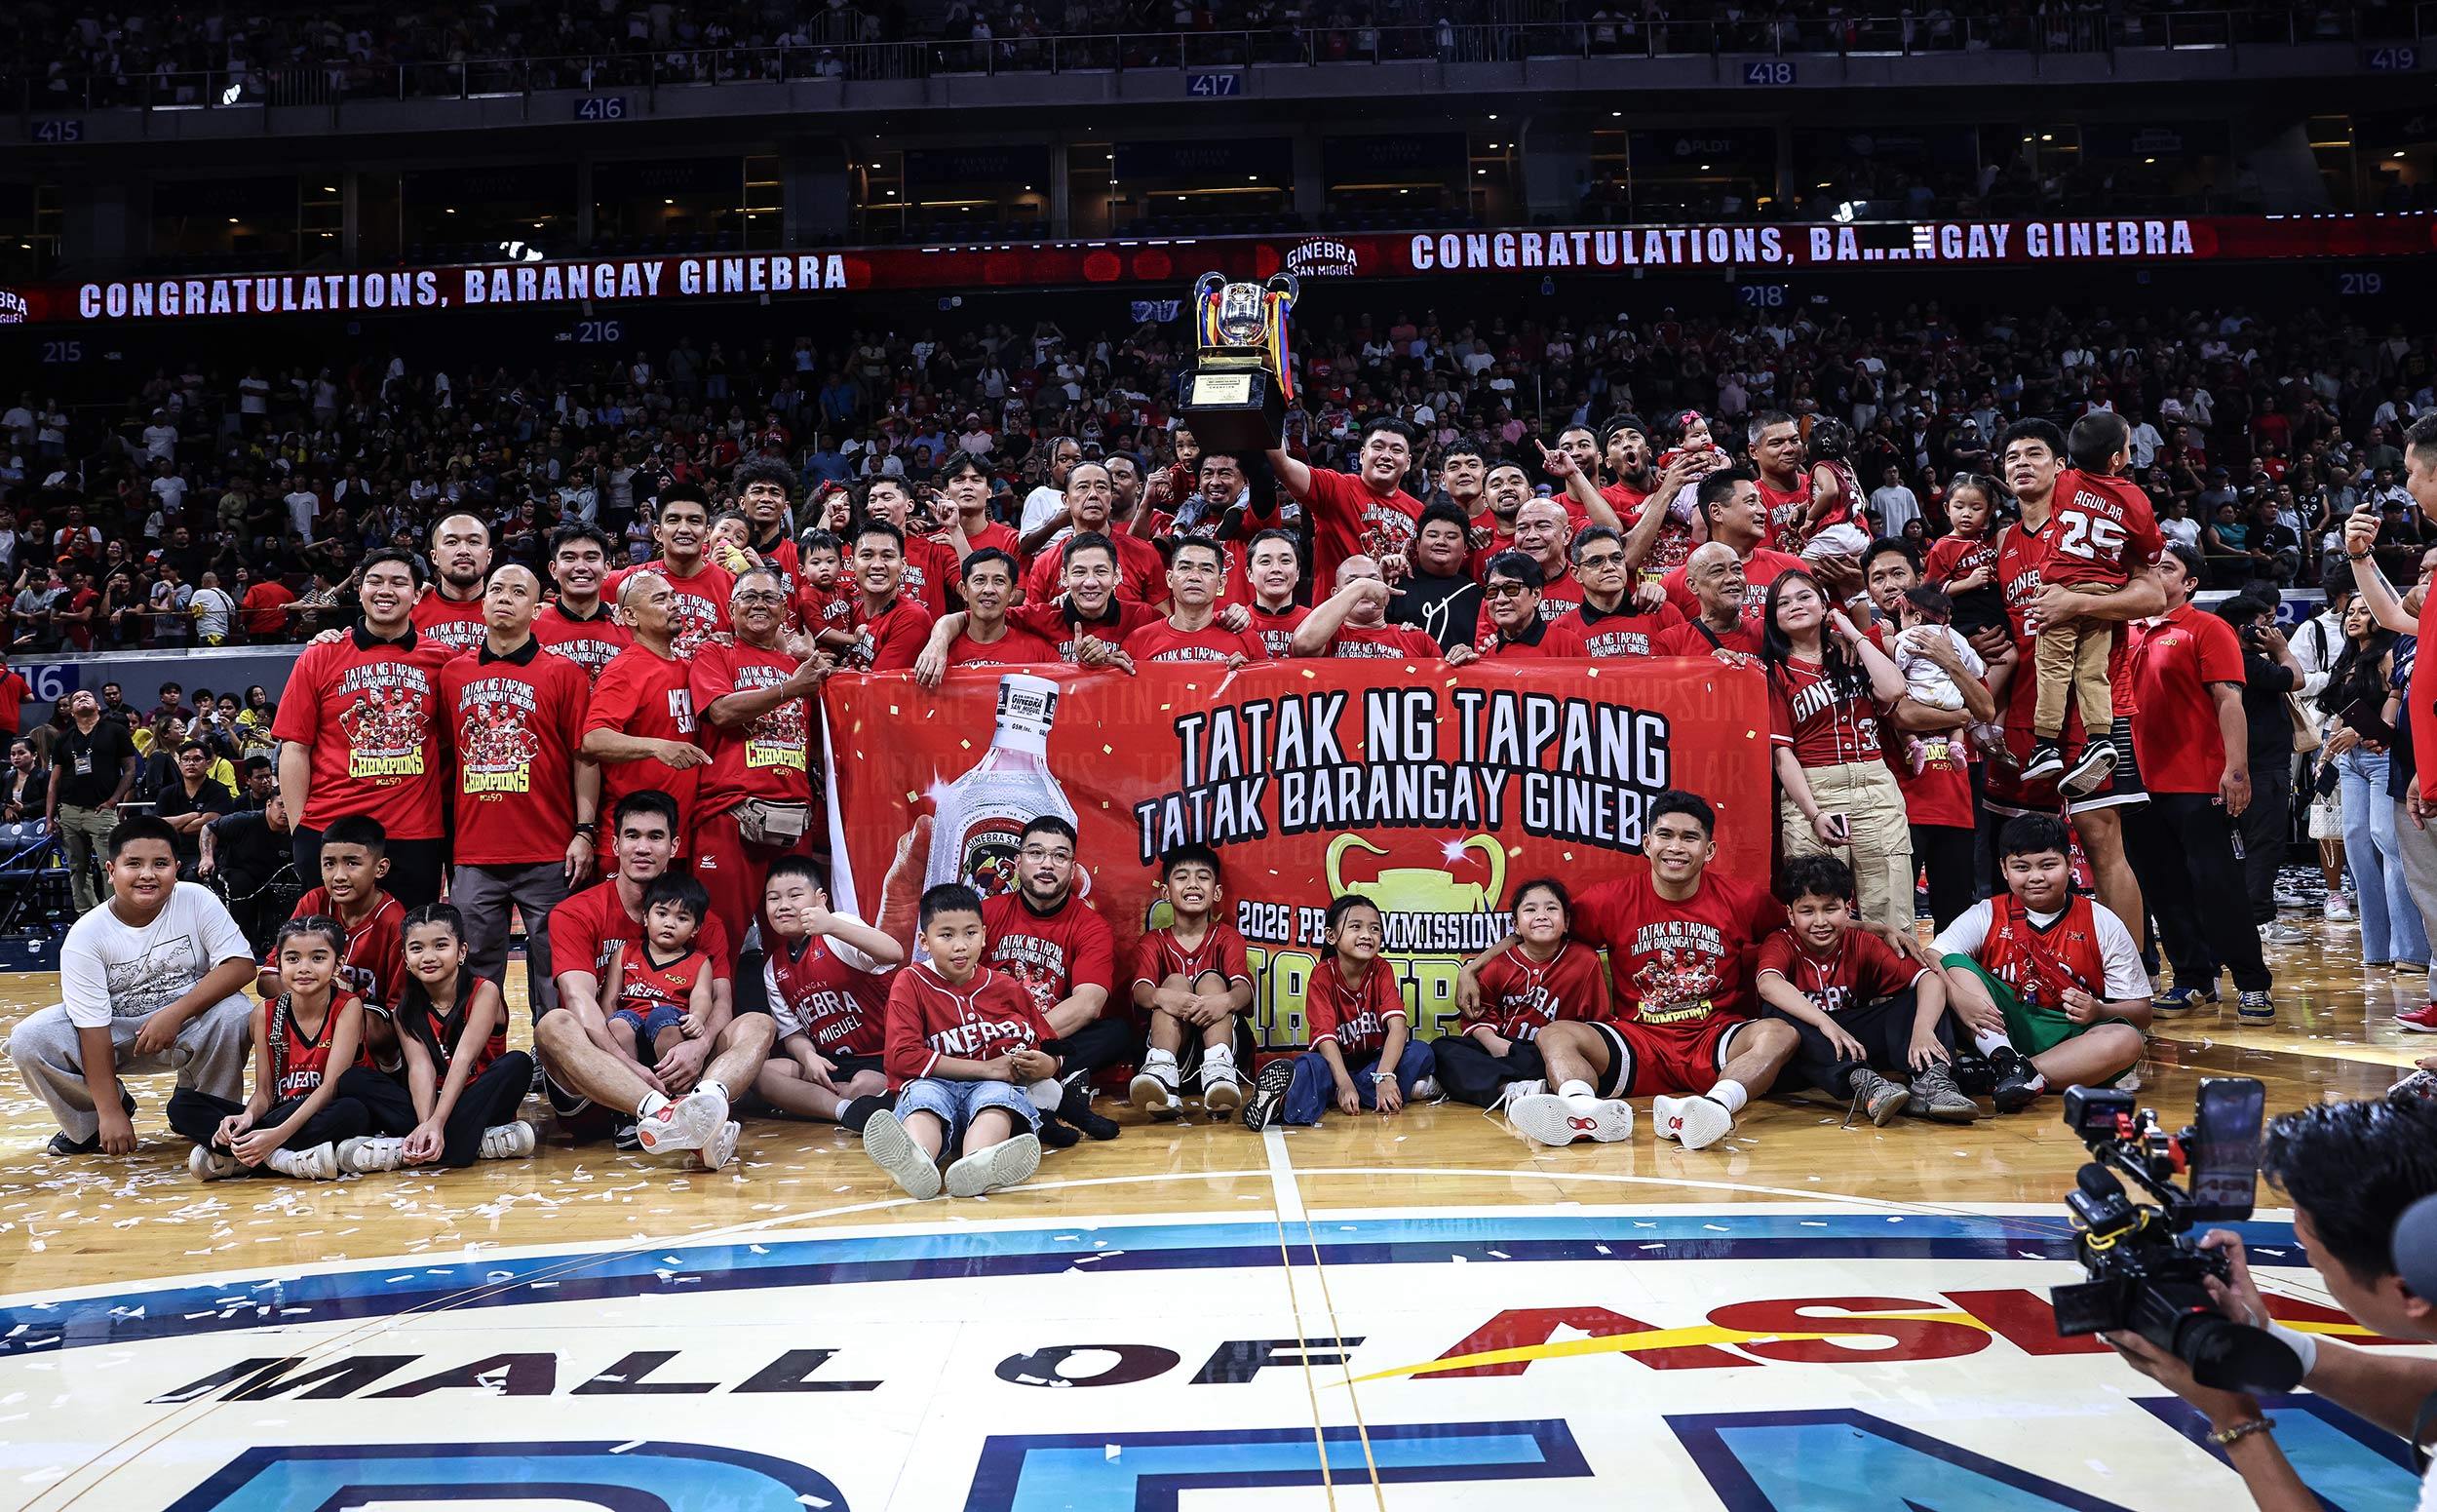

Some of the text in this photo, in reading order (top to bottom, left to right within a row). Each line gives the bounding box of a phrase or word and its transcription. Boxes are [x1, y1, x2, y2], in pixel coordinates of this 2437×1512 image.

[2370, 48, 2414, 69] 419
[1748, 64, 1792, 83] 418
[1192, 75, 1235, 95] 417
[579, 98, 622, 119] 416
[36, 121, 78, 141] 415
[1411, 226, 1794, 270] CONGRATULATIONS,
[2027, 219, 2194, 258] GINEBRA
[1287, 242, 1358, 268] GINEBRA
[1293, 264, 1355, 277] SAN MIGUEL
[79, 253, 847, 320] CONGRATULATIONS, BARANGAY GINEBRA
[2340, 274, 2382, 293] 219
[1741, 286, 1783, 306] 218
[579, 323, 621, 342] 216
[41, 341, 82, 363] 215
[2073, 489, 2124, 522] AGUILAR
[2058, 509, 2129, 562] 25
[2006, 569, 2041, 601] GINEB
[686, 595, 716, 614] TAPANG
[695, 605, 718, 625] GINEBRA
[425, 621, 487, 638] TATAK NG TAPA
[1267, 631, 1279, 641] NG
[1603, 634, 1614, 645] NG
[1615, 632, 1649, 646] TAPANG
[576, 640, 589, 652] NG
[590, 640, 622, 657] TAPANG
[1180, 647, 1192, 659] NG
[1338, 641, 1404, 658] TATAK NG TAPANG
[1591, 643, 1650, 658] BARANGAY GINEBR
[344, 662, 426, 683] TATAK NG TAPANG
[761, 666, 773, 678] NG
[338, 675, 431, 697] TATAK BARANGAY GINEBRA
[461, 678, 535, 698] TATAK NG TAPANG
[473, 691, 508, 704] BARANGAY
[510, 692, 537, 713] GINEBRA
[1012, 694, 1044, 709] GINEBRA
[1792, 678, 1840, 723] GINE
[1022, 706, 1041, 716] MIGUEL
[1177, 691, 1347, 791] TATAK
[1367, 689, 1435, 763] NG
[1455, 690, 1668, 791] TAPANG
[349, 745, 425, 778] CHAMPIONS
[463, 762, 530, 795] CHAMPIONS
[1137, 775, 1267, 861] TATAK
[1282, 762, 1508, 830] BARANGAY
[1524, 770, 1659, 849] GINEB
[966, 833, 1005, 850] GINEBRA
[1238, 900, 1291, 944] 2026
[1297, 908, 1327, 946] PB
[1637, 920, 1721, 943] TATAK NG TAPANG
[998, 934, 1025, 951] TATAK
[1025, 937, 1040, 950] NG
[1631, 936, 1725, 958] TATAK BARANGAY GINEBRA
[991, 948, 1011, 962] TATAK
[1011, 947, 1047, 965] BARANGAY
[818, 1015, 863, 1046] MIGUEL
[143, 1345, 883, 1404] MALL
[994, 1336, 1365, 1389] OF
